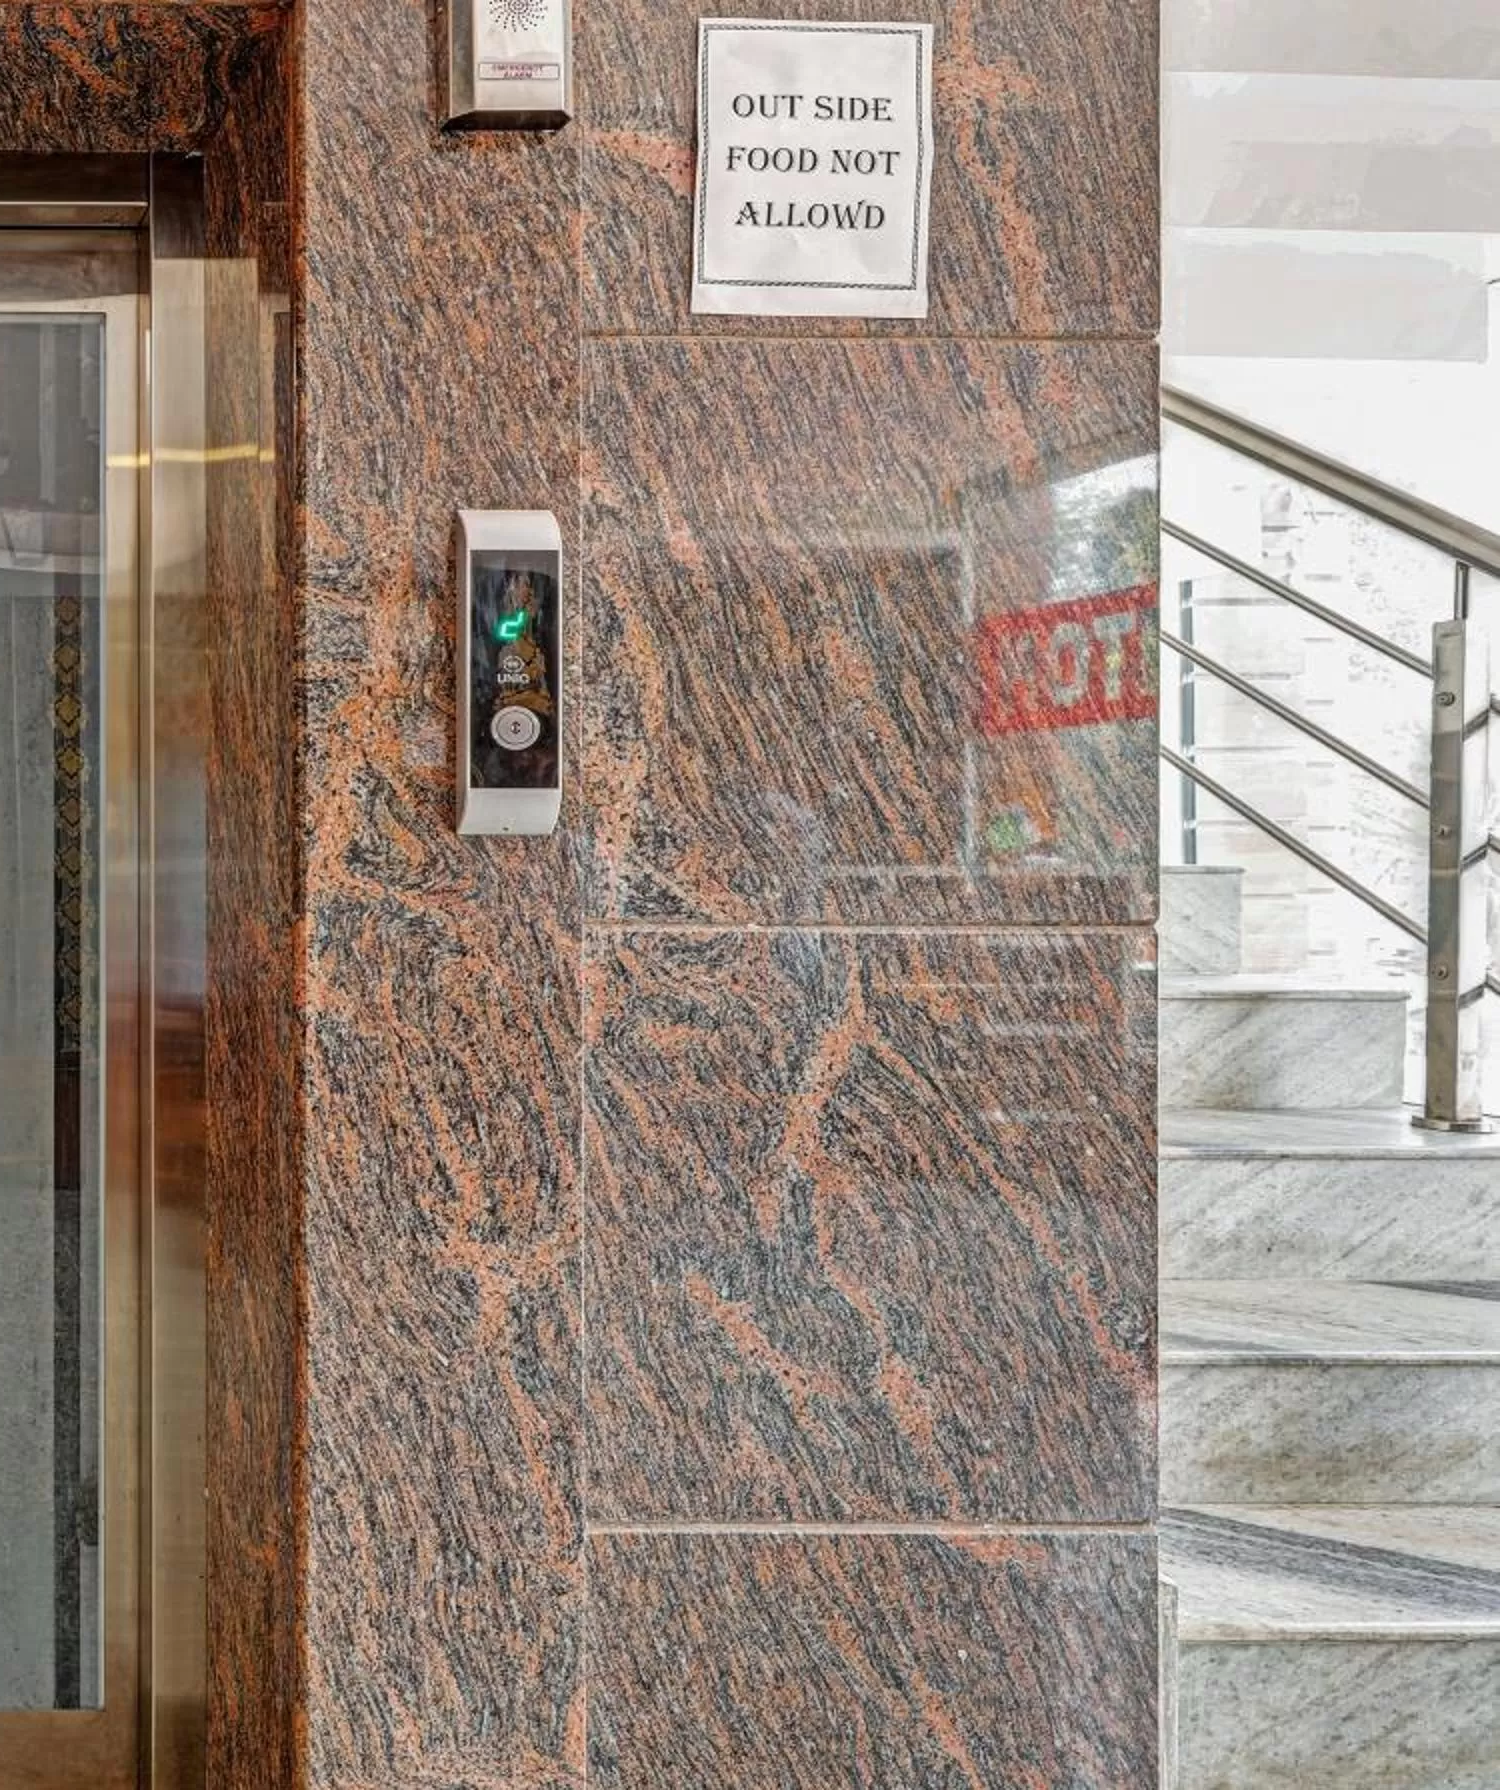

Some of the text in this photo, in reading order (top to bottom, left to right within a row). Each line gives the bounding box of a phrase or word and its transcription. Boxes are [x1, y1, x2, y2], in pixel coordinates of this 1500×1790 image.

[732, 94, 893, 122] OUT SIDE
[726, 146, 901, 176] FOOD NOT
[734, 199, 886, 230] ALLOWD
